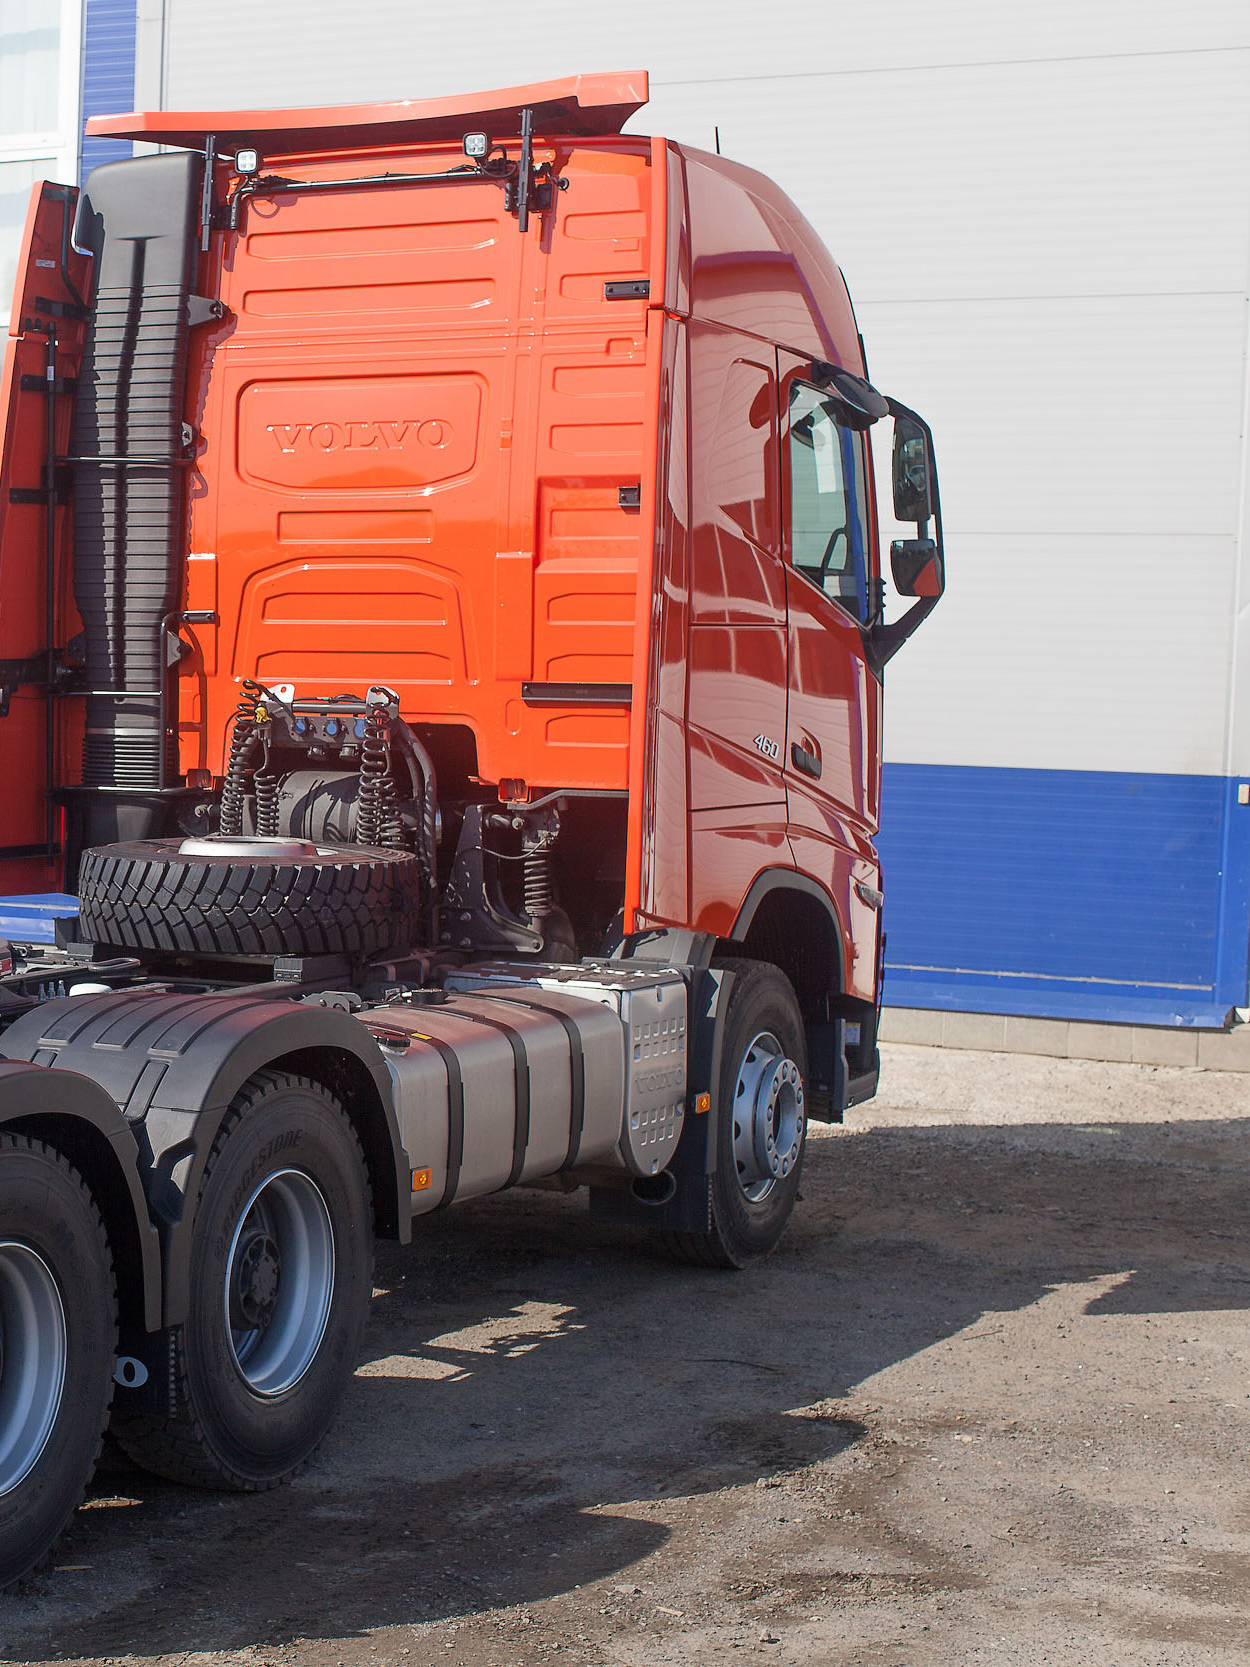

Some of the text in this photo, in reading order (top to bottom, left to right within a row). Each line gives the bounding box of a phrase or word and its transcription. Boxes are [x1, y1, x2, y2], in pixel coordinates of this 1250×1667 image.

[266, 418, 454, 453] VOLVO
[753, 733, 779, 759] 460
[634, 1066, 684, 1095] VOLVO
